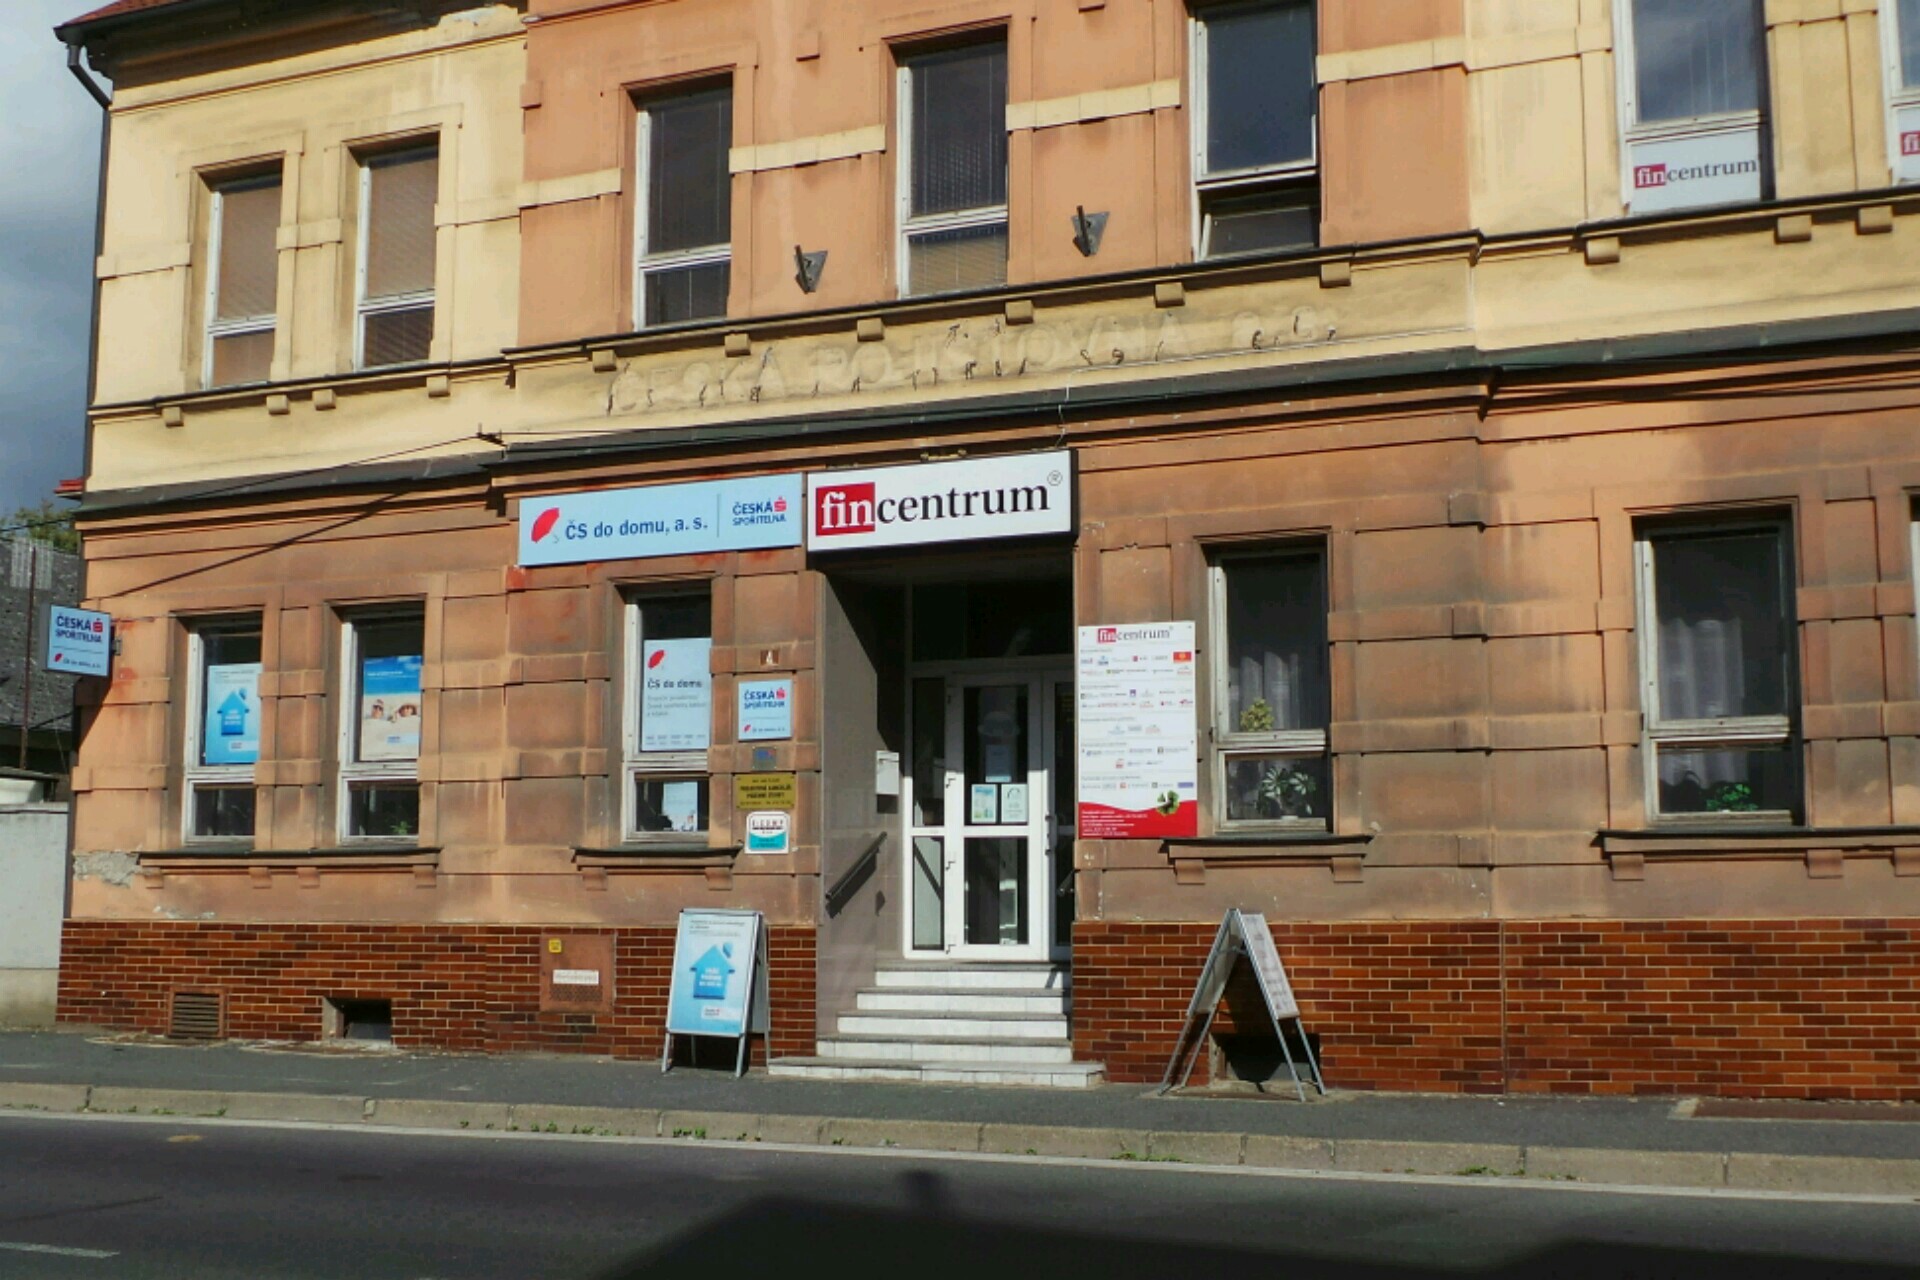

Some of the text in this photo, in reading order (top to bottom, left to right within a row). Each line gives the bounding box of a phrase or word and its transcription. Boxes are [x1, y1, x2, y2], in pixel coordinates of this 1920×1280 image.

[1637, 160, 1757, 187] fincentrum
[732, 497, 773, 516] ČESKÁ
[820, 484, 1051, 529] fincentrum
[565, 519, 588, 540] ČS
[593, 521, 613, 538] do
[619, 519, 670, 537] domu,
[732, 513, 787, 527] SPOŘITELNA
[55, 612, 92, 631] ČESKÁ
[1099, 629, 1170, 642] fincentrum
[744, 688, 775, 700] ČESKÁ
